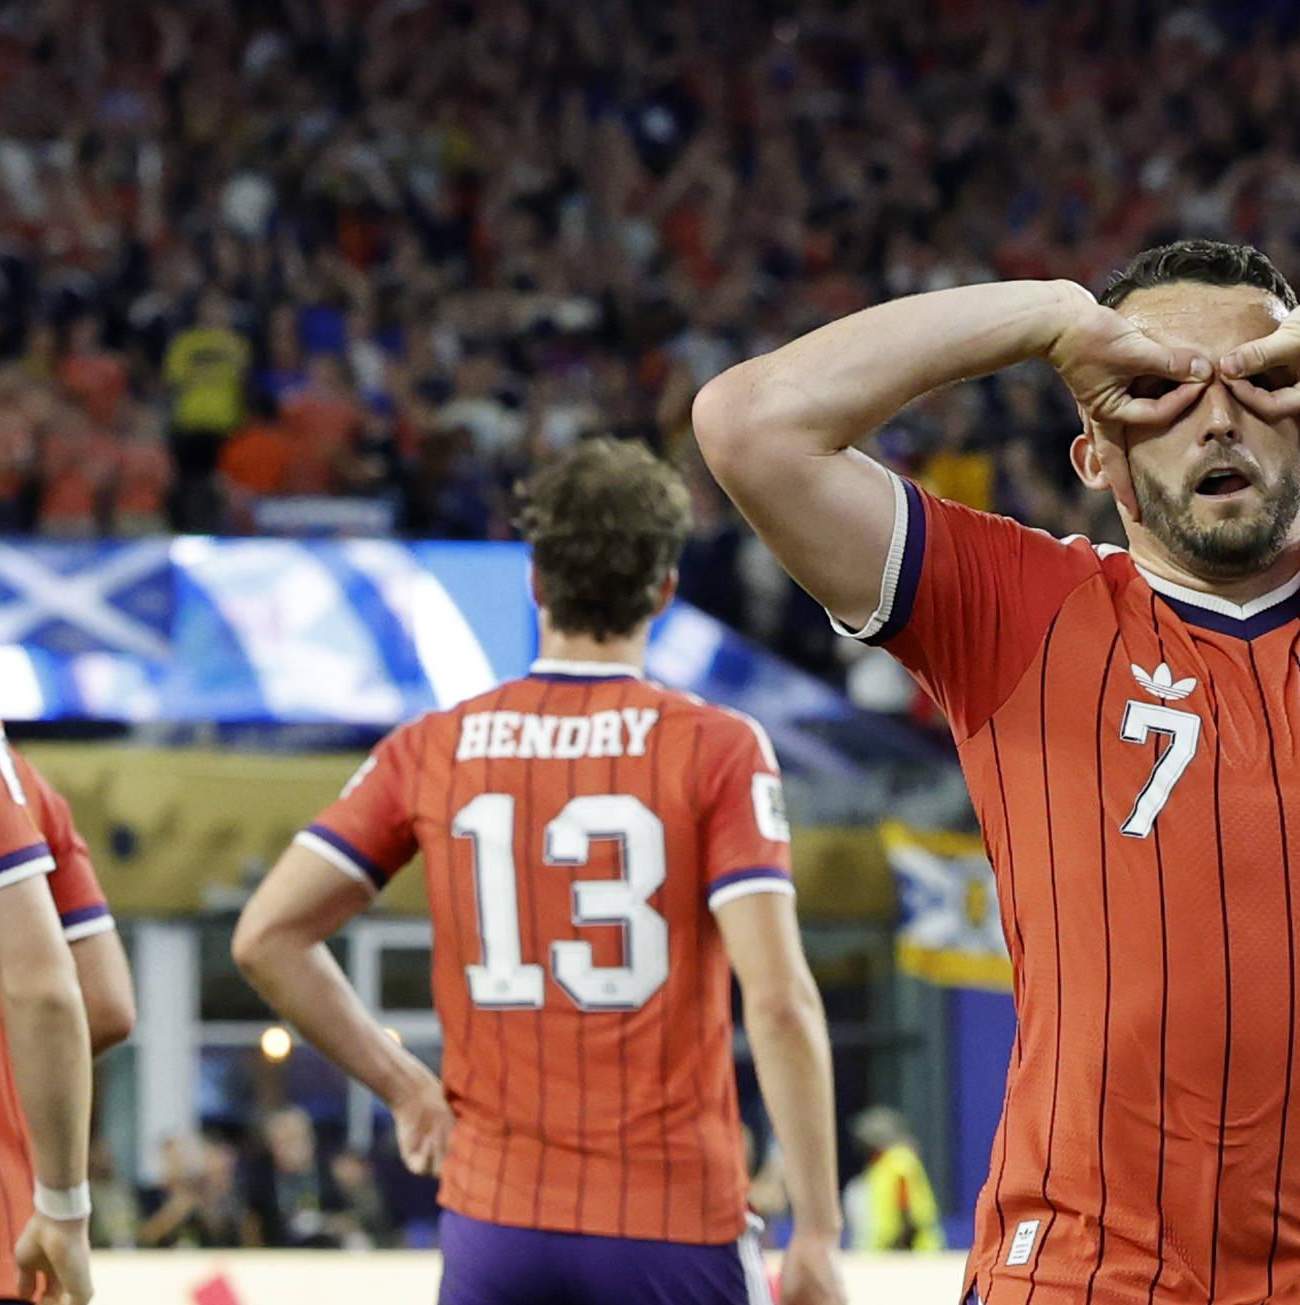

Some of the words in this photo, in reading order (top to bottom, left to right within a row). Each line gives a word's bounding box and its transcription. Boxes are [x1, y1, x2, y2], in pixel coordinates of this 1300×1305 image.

[456, 707, 660, 762] HENDRY
[1119, 699, 1202, 839] 7
[451, 792, 670, 1013] 13
